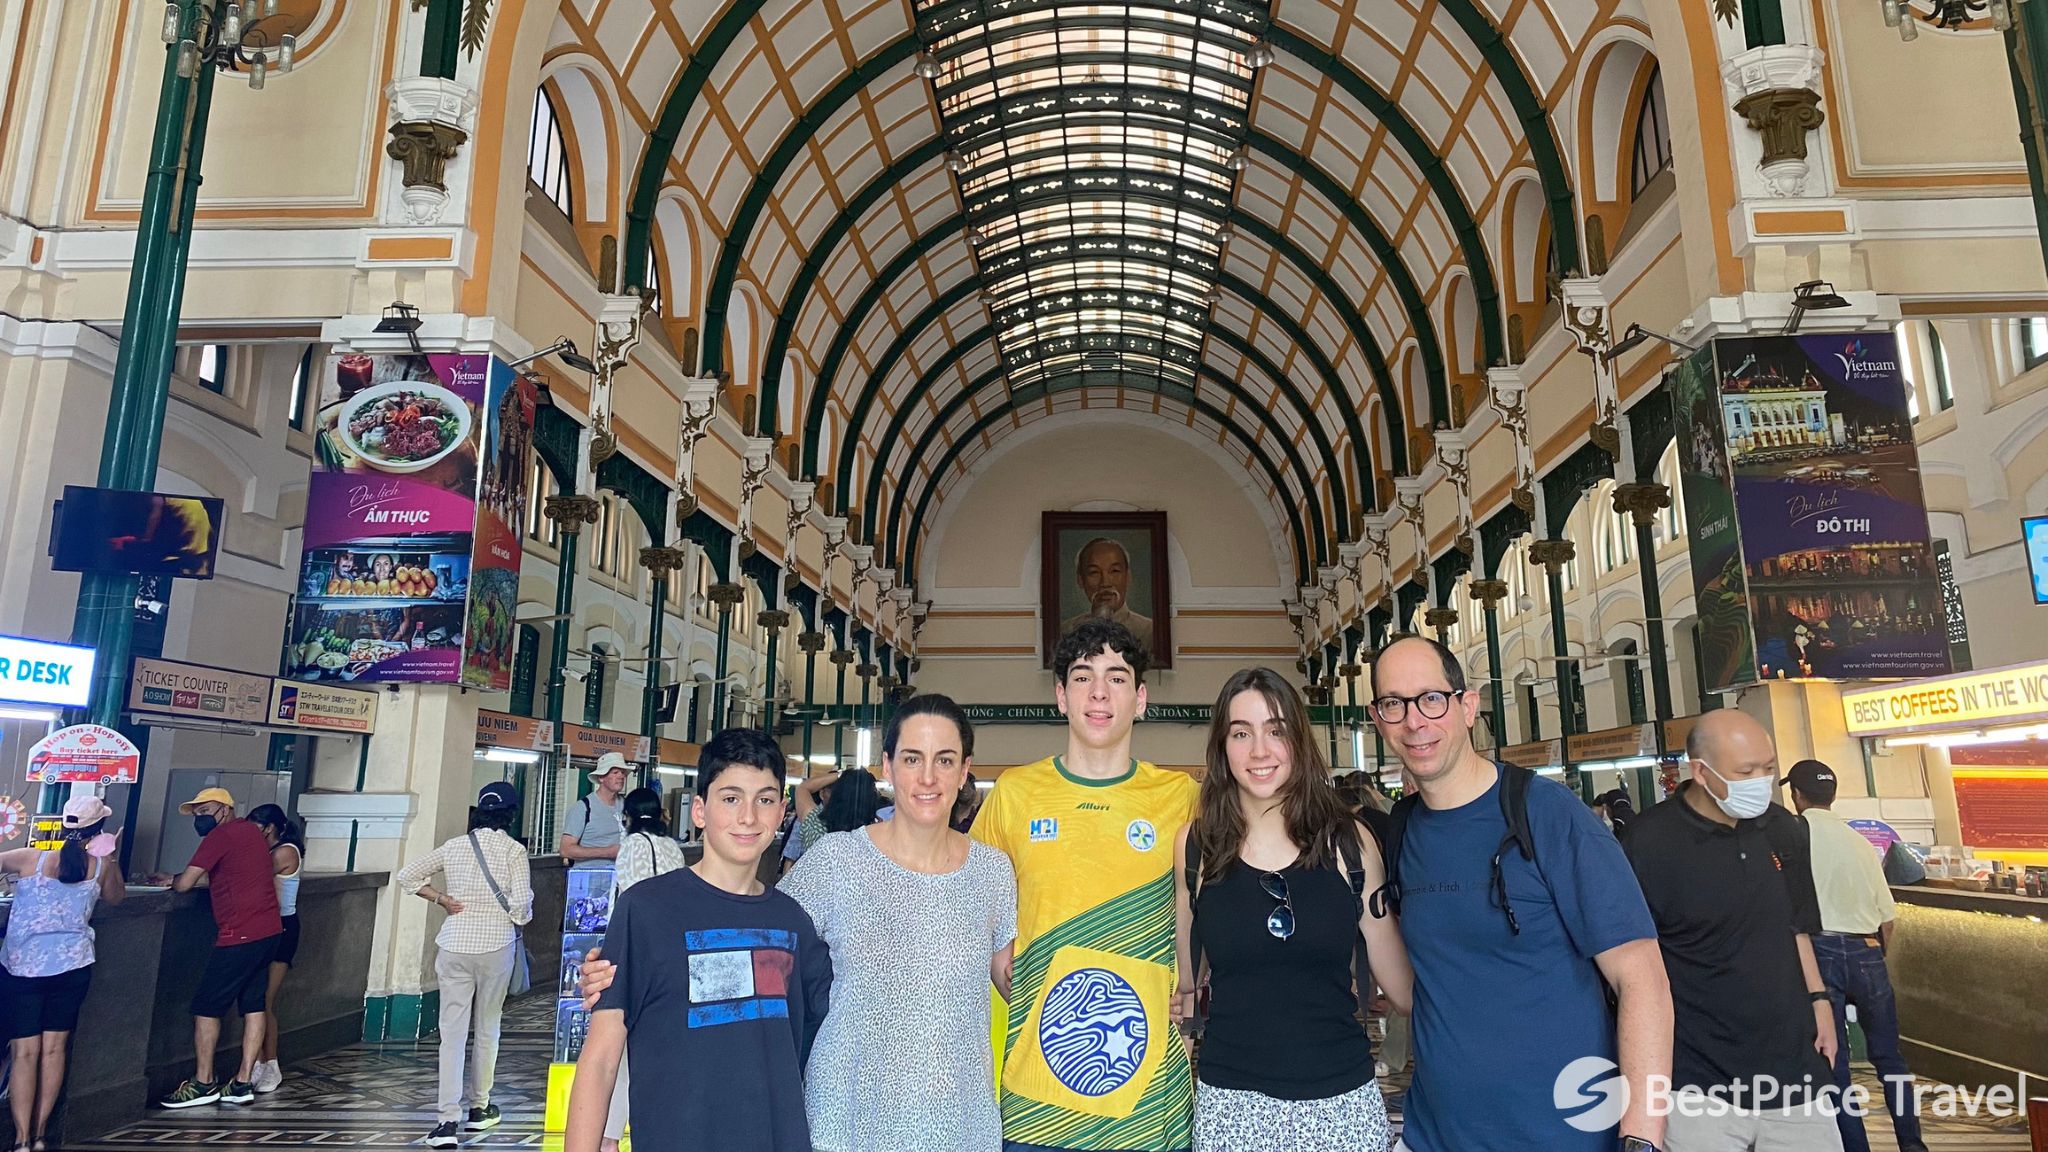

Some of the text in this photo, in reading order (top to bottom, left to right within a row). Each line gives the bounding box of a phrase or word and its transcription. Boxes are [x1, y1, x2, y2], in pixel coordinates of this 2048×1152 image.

[449, 367, 485, 386] Vietnam
[1834, 353, 1896, 381] Vietnam
[348, 481, 399, 507] Du lịch
[1786, 489, 1838, 518] Du lịch
[390, 510, 430, 526] THỰC
[1816, 516, 1870, 535] ĐÔ THỊ
[16, 659, 73, 686] DESK
[1842, 662, 1945, 670] www.vietnamtourism.gov.vn
[145, 670, 228, 694] TICKET COUNTER
[1007, 706, 1044, 718] CHÍNH
[1161, 706, 1190, 718] TOÀN
[1854, 698, 1887, 723] BEST
[1890, 687, 1959, 720] COFFEES
[1961, 685, 1979, 712] IN
[1980, 680, 2018, 709] THE
[43, 731, 67, 750] Hop
[69, 727, 84, 735] on
[93, 726, 115, 740] Hop
[115, 737, 131, 752] off
[60, 747, 74, 755] Buy
